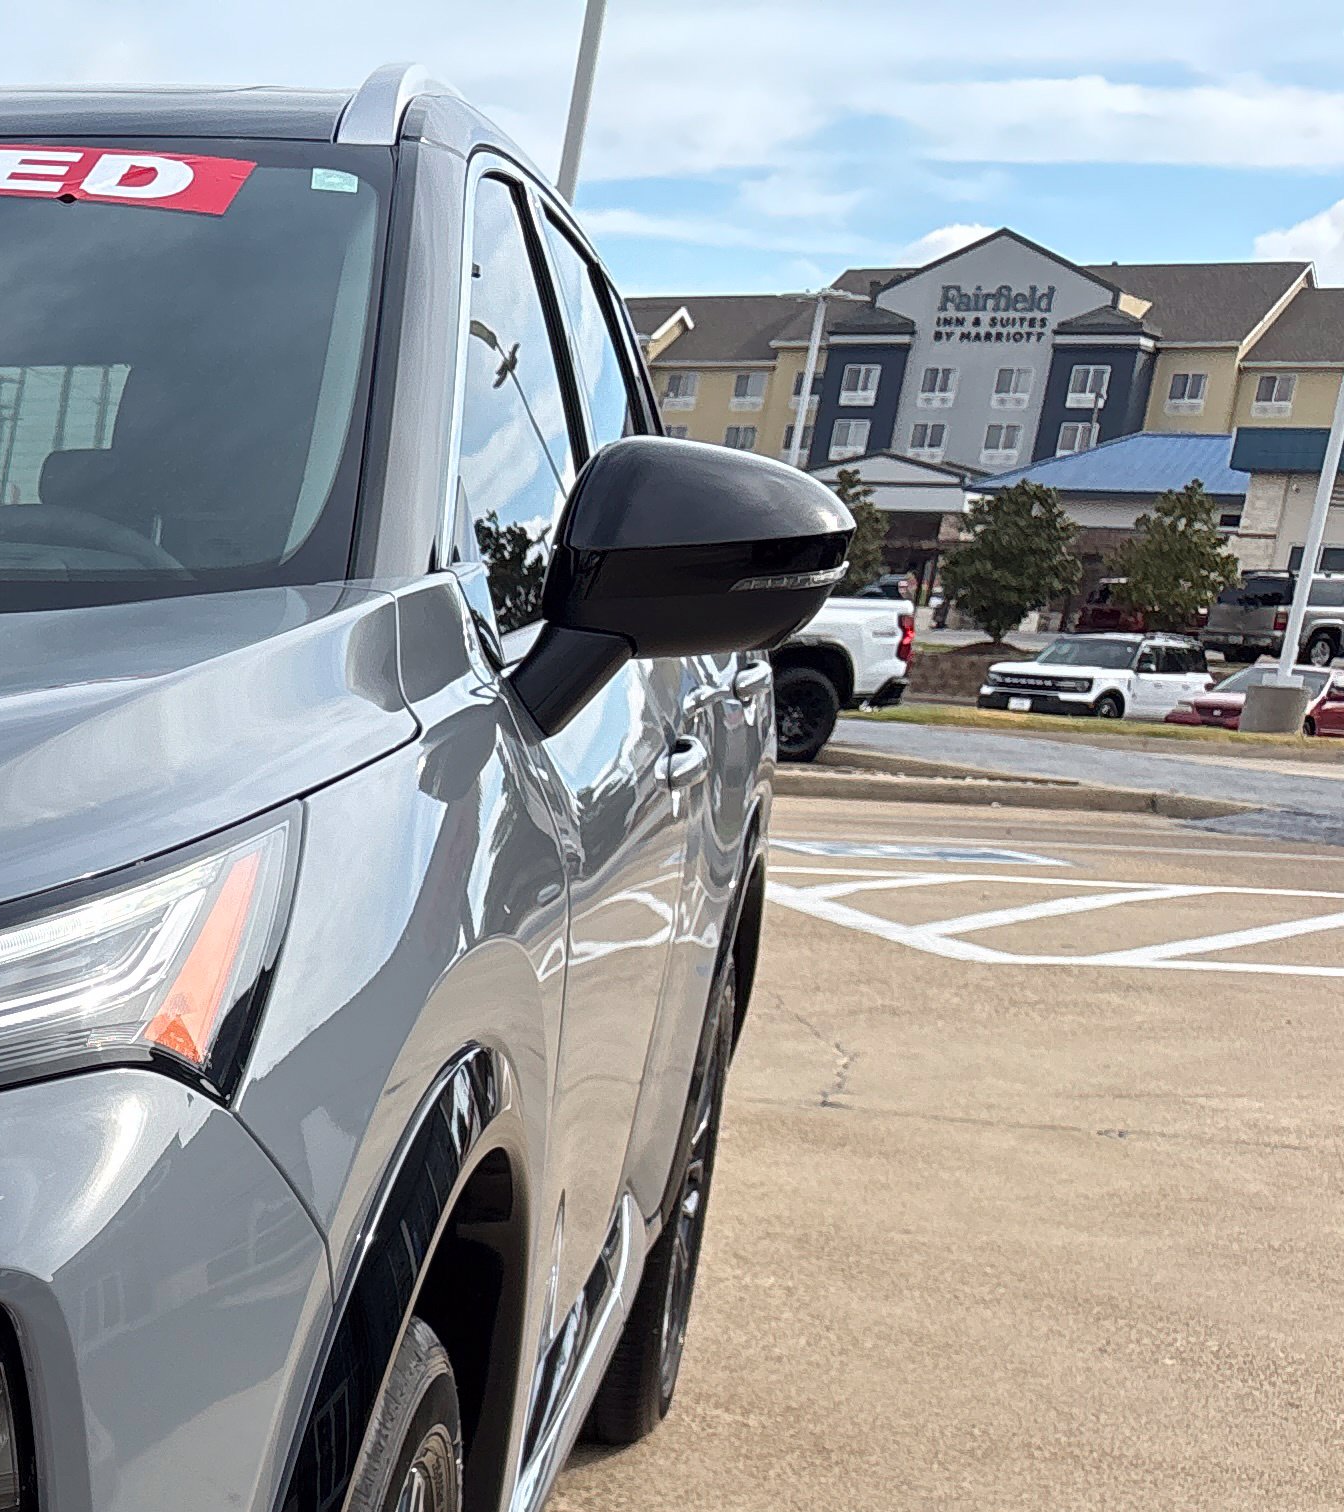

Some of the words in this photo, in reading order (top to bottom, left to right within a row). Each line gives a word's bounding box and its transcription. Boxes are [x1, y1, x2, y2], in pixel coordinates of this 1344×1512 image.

[937, 284, 1056, 312] Fairfield
[936, 316, 966, 327] INN
[989, 316, 1048, 328] SUITES
[934, 330, 954, 342] BY
[959, 331, 1045, 343] MARRIOTT
